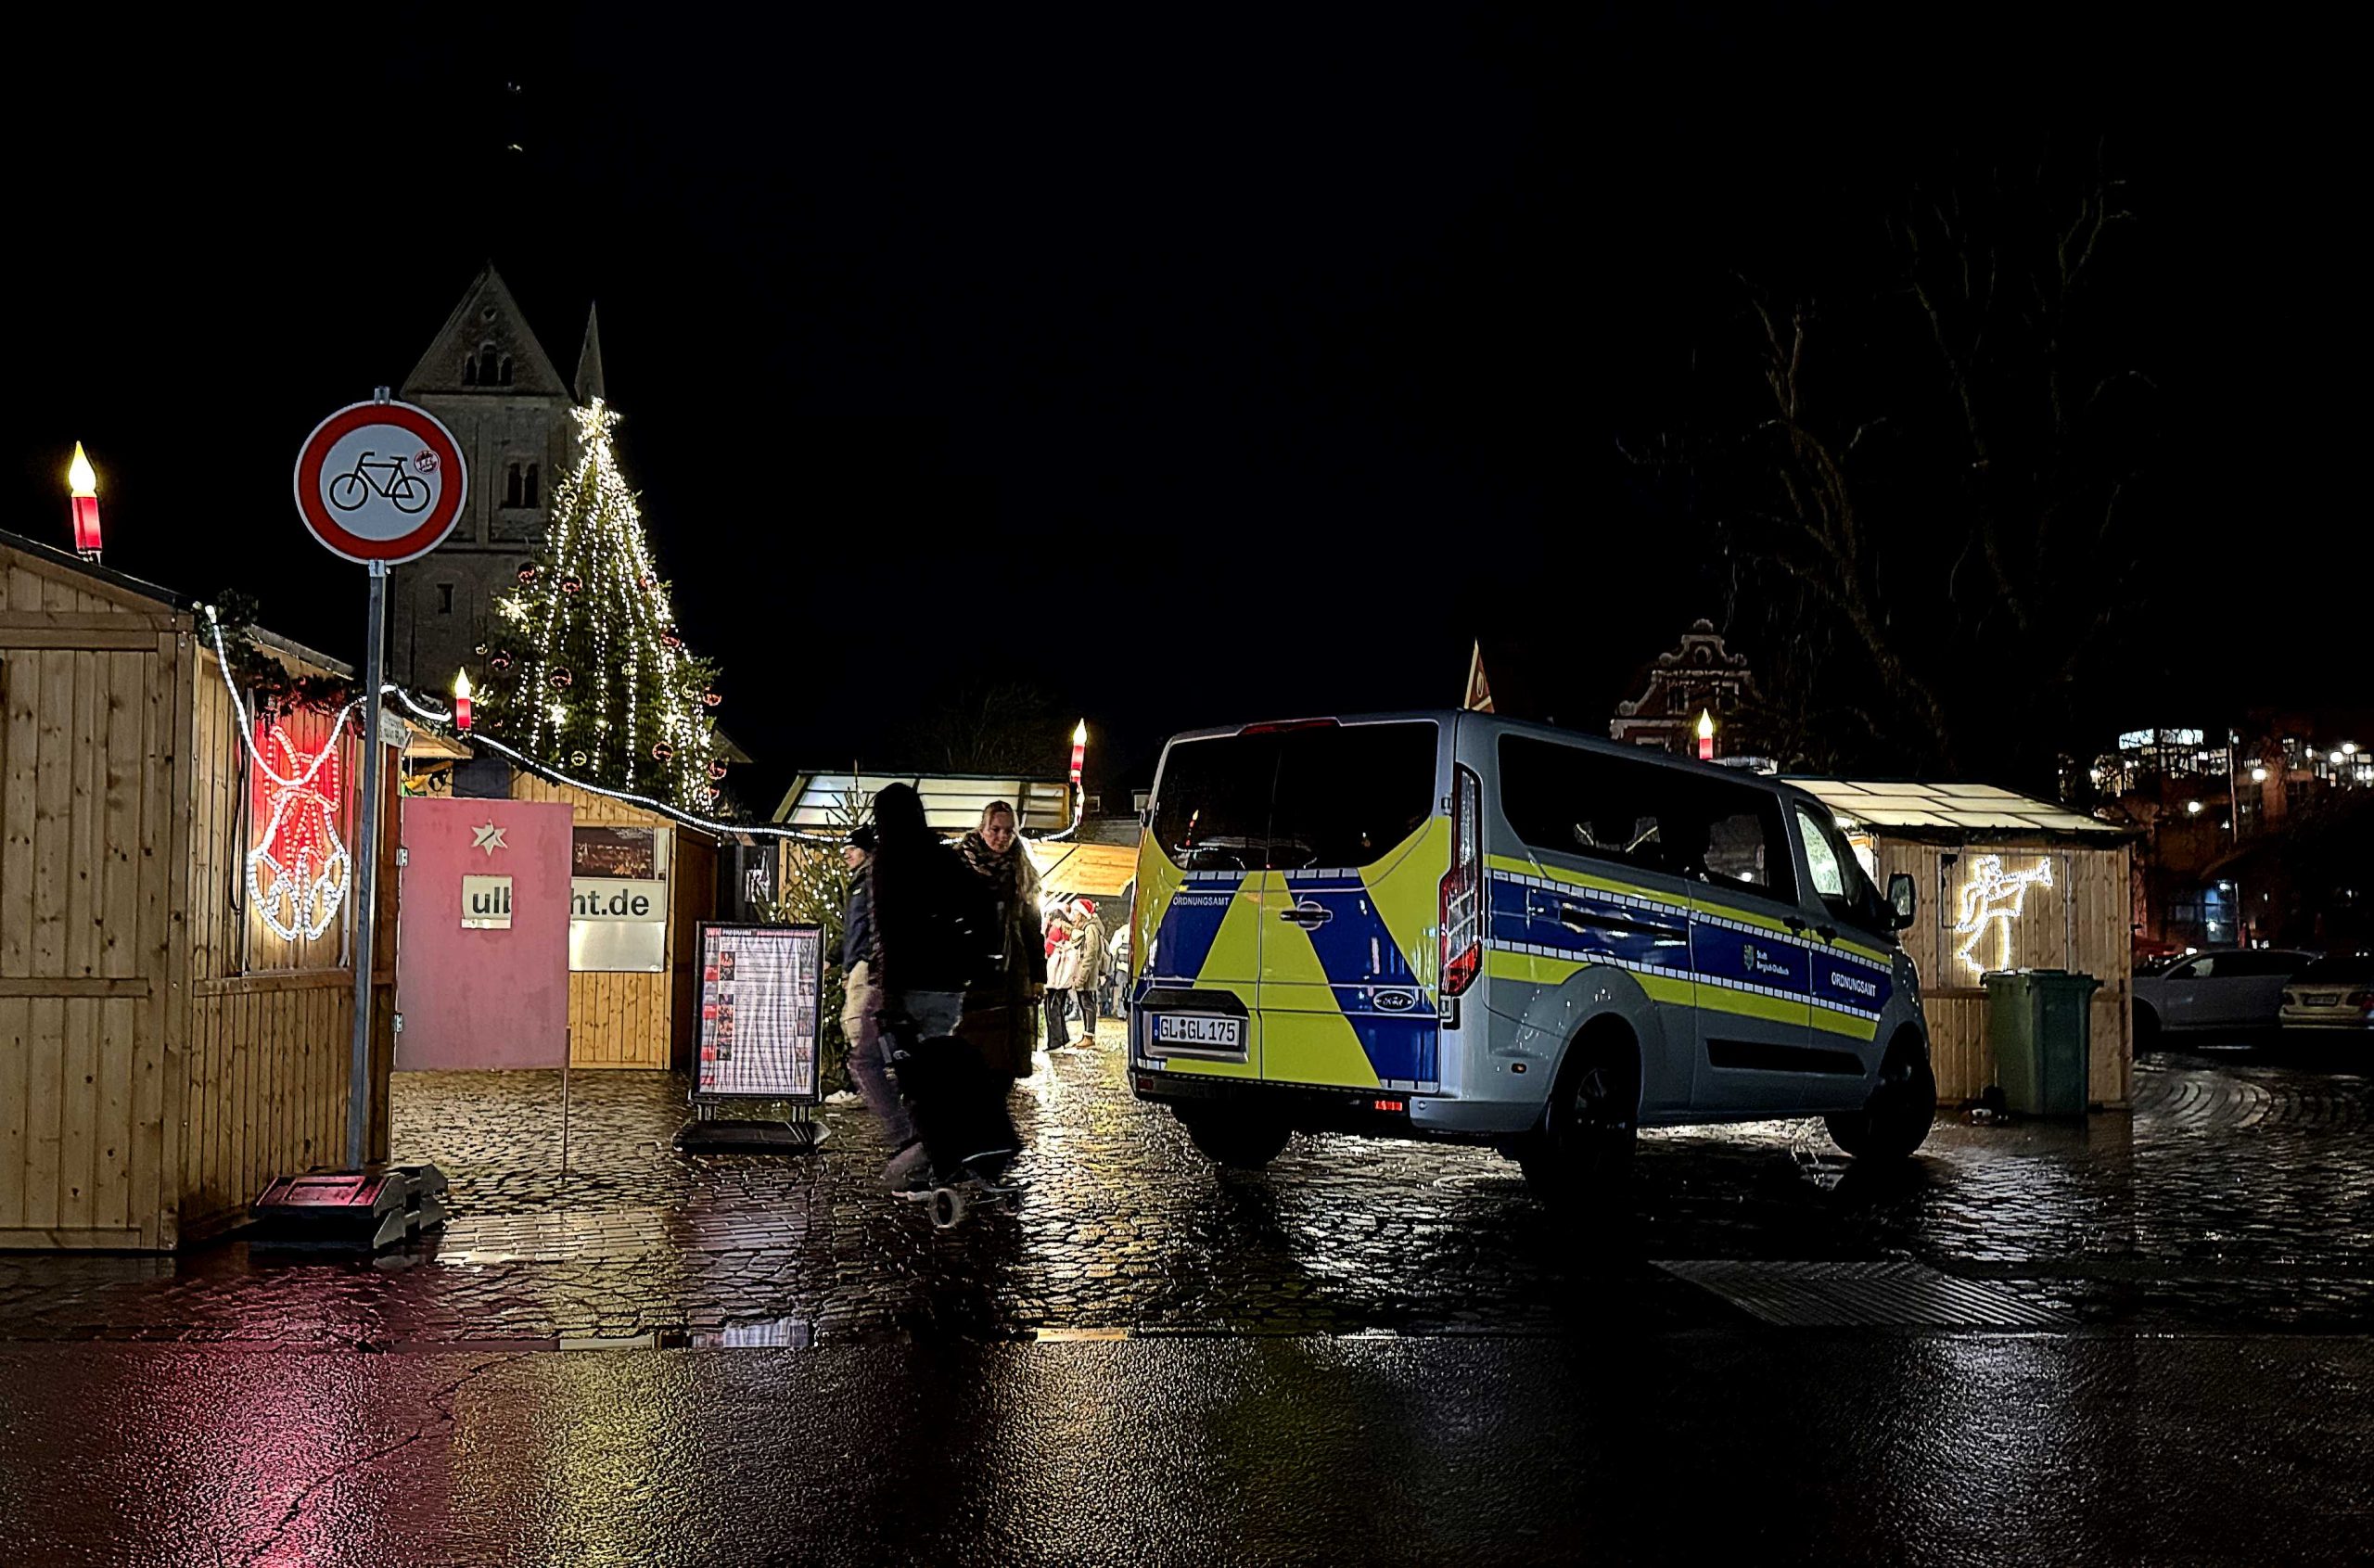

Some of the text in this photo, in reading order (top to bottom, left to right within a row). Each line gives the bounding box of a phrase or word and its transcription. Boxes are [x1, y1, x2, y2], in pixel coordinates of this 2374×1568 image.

[570, 887, 650, 916] ht.de
[1172, 896, 1231, 906] ORDNUNGSAMT
[1831, 971, 1877, 998] ORDNUNGSAMT
[1160, 1018, 1236, 1042] GL GL 175
